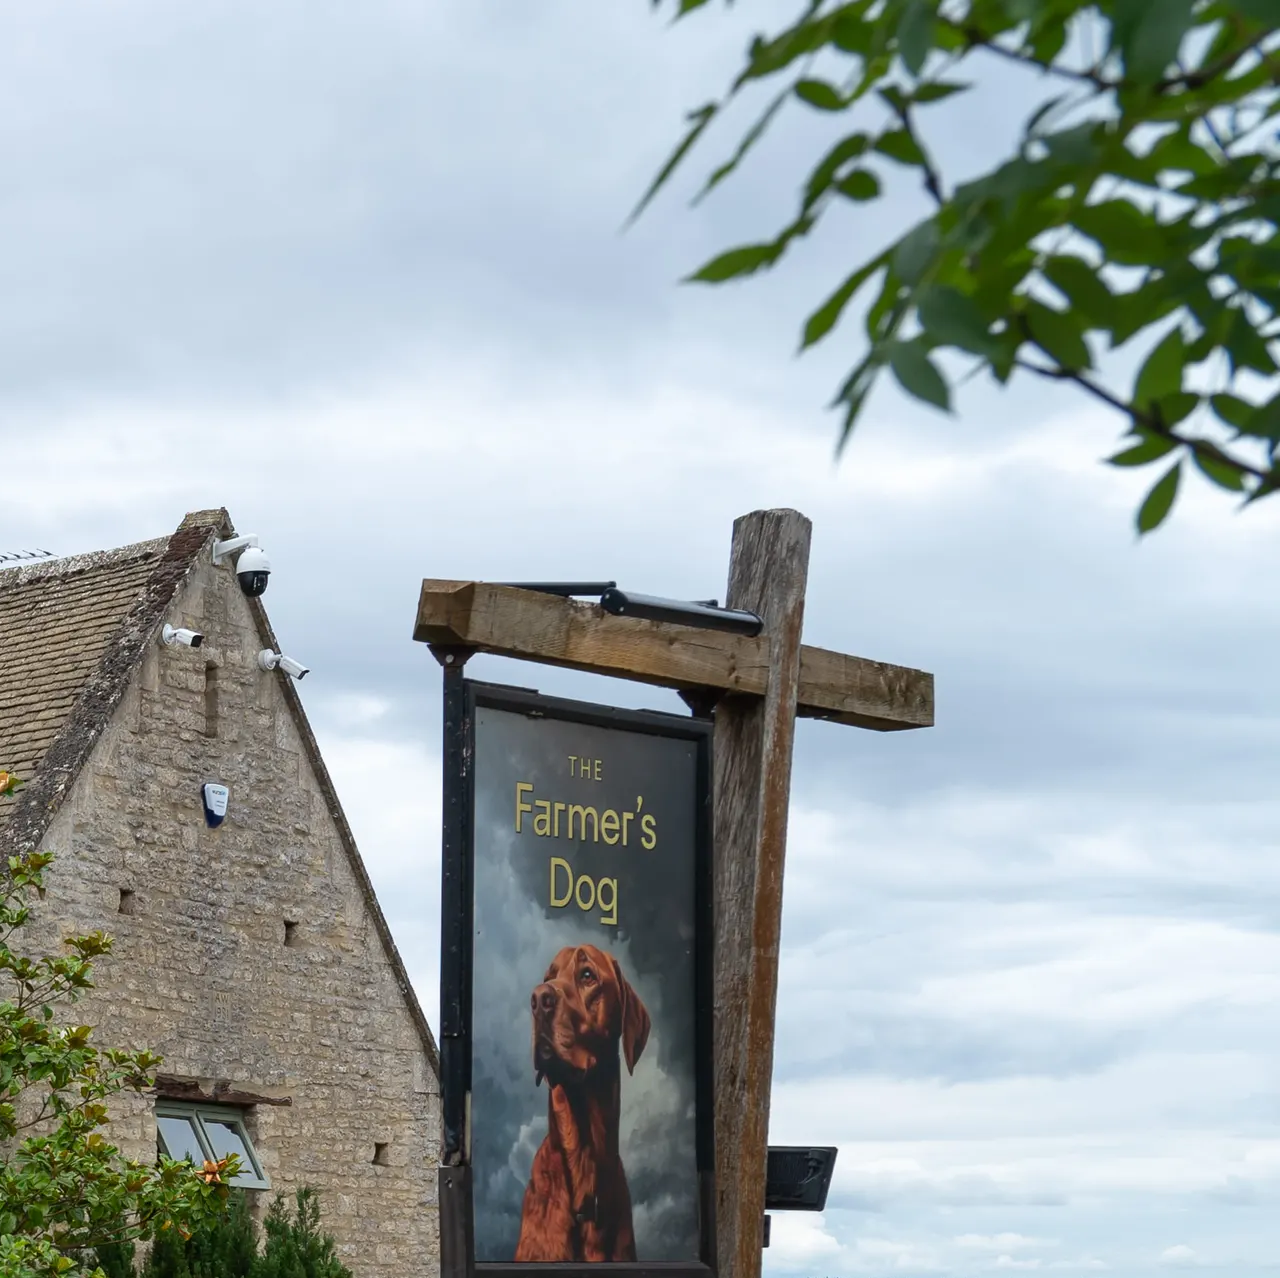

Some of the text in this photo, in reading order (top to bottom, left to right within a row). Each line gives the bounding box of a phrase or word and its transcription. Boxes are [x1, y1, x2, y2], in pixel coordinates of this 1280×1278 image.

[568, 755, 602, 780] THE
[515, 782, 657, 850] Farmer's
[550, 857, 618, 925] Dog
